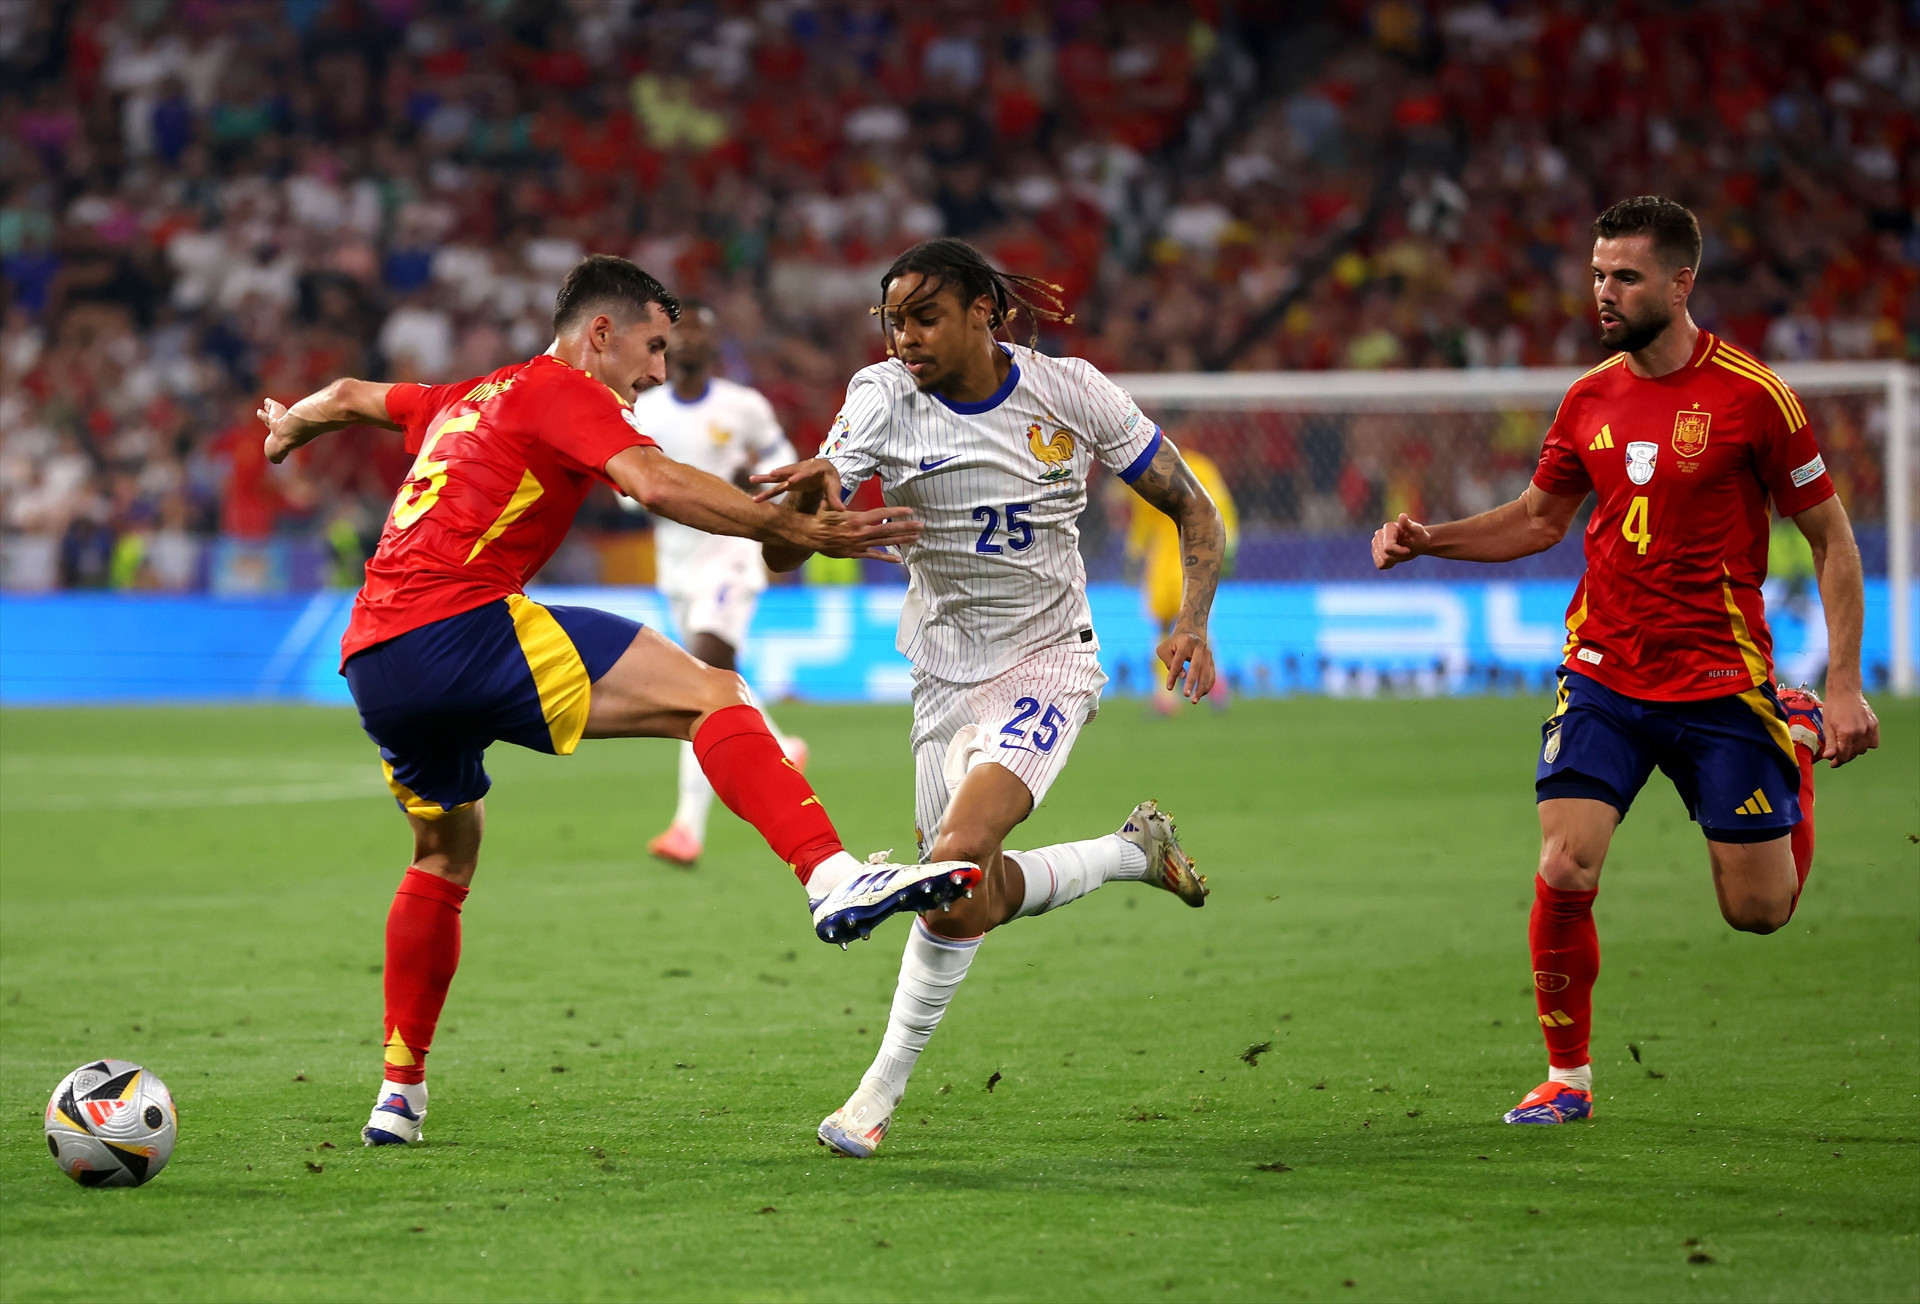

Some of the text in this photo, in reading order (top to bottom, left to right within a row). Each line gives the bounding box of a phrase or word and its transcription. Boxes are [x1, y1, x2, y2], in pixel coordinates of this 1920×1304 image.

[393, 412, 481, 530] 5
[972, 504, 1036, 555] 25
[1622, 496, 1652, 555] 4
[1000, 696, 1067, 755] 25
